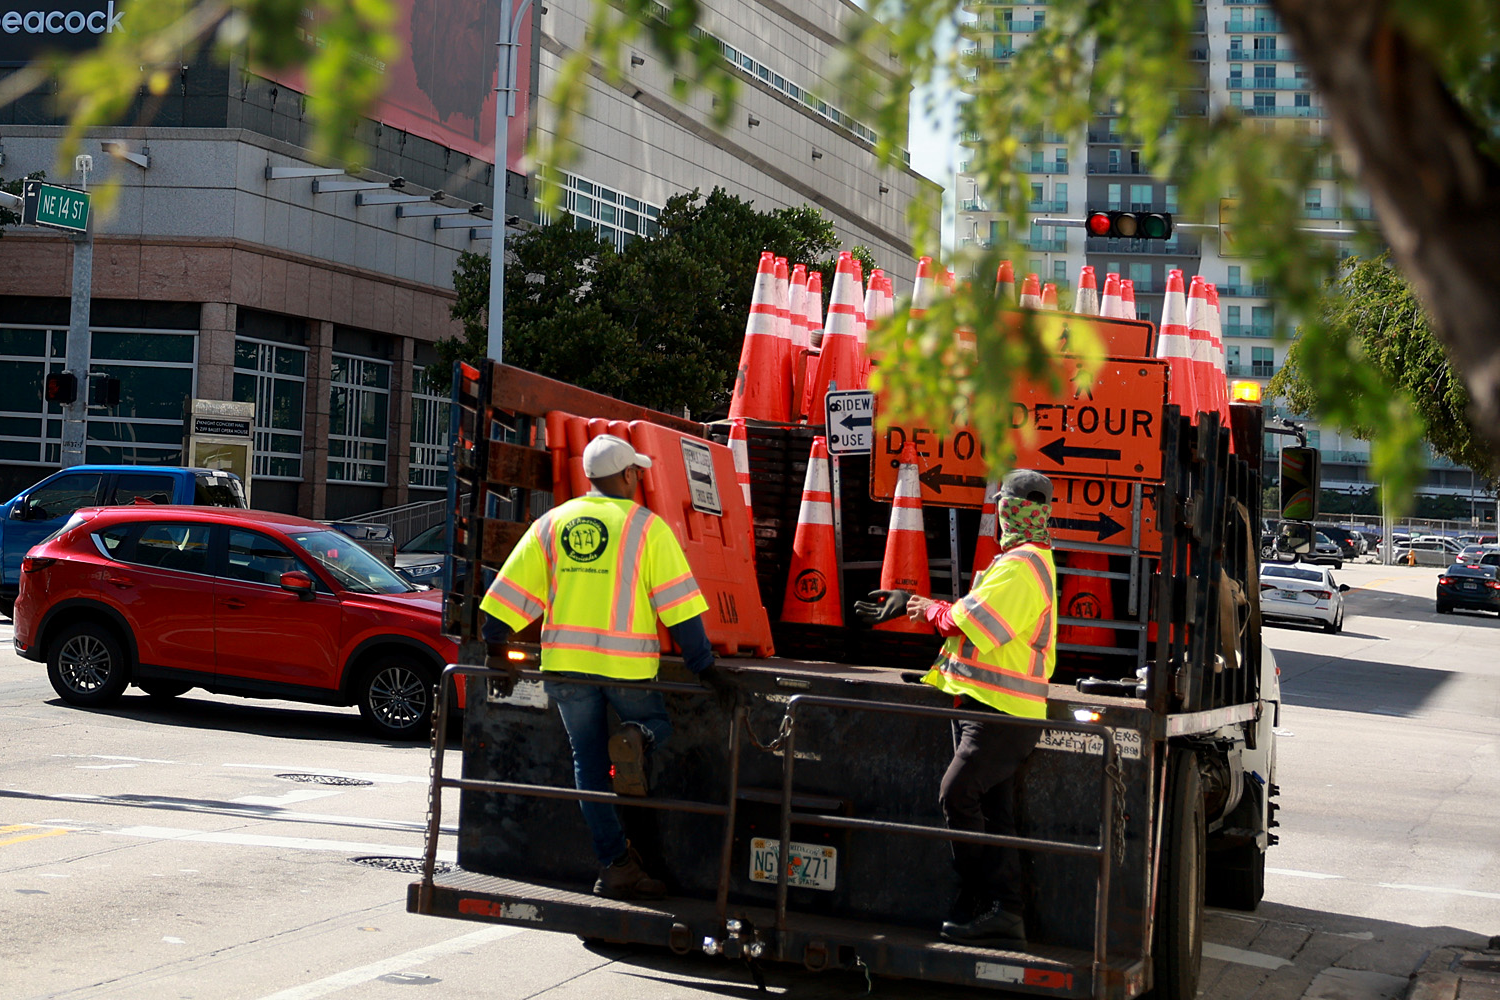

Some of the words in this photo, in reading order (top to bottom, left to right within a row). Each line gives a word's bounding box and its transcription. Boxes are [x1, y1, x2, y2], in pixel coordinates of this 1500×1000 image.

[42, 194, 57, 215] NE
[58, 195, 70, 219] 14
[71, 200, 85, 220] ST
[1008, 402, 1153, 438] DETOUR
[841, 434, 865, 447] USE
[1052, 477, 1157, 511] TOUR
